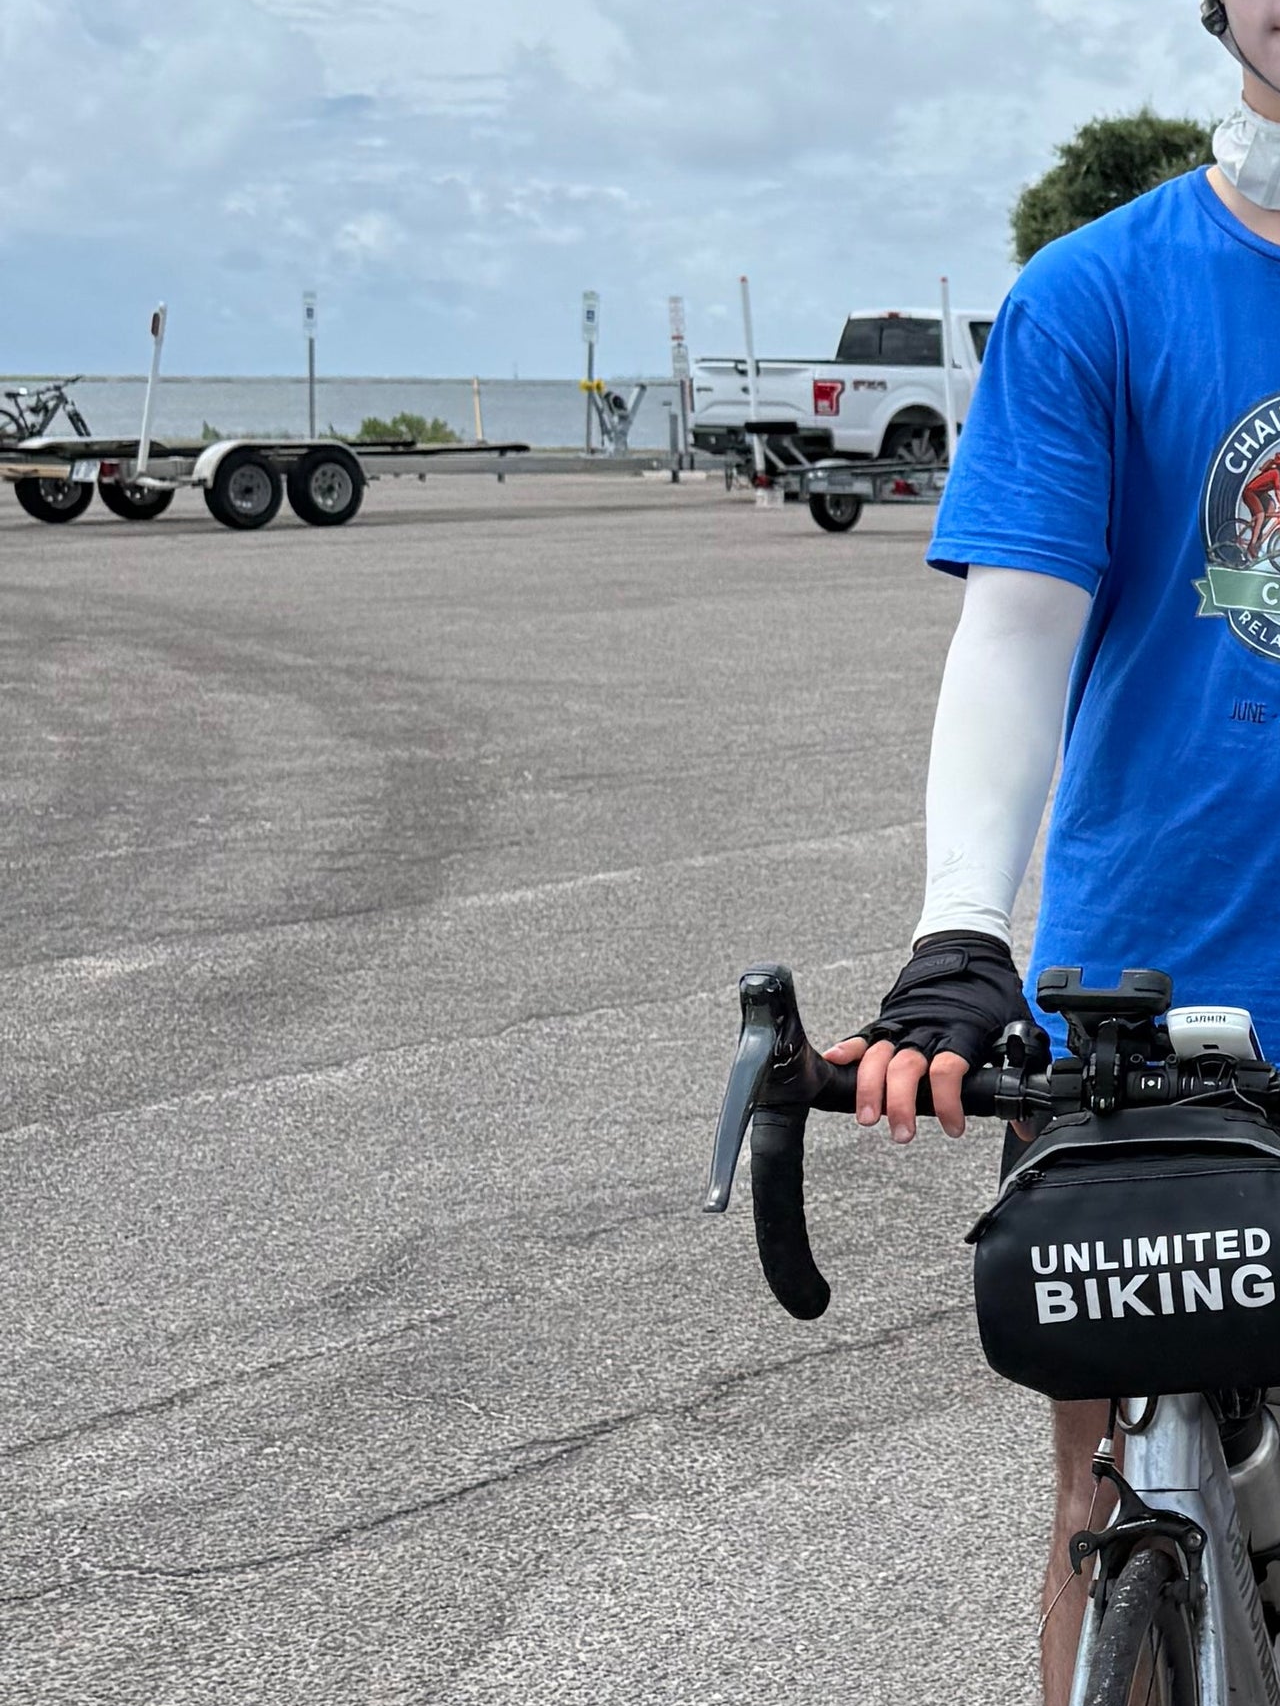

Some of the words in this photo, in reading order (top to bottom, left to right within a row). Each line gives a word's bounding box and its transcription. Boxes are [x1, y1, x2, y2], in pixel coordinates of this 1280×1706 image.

[1230, 701, 1266, 724] JUNE
[1186, 1015, 1227, 1024] GARMIN
[1031, 1227, 1273, 1274] UNLIMITED
[1033, 1263, 1277, 1325] BIKING
